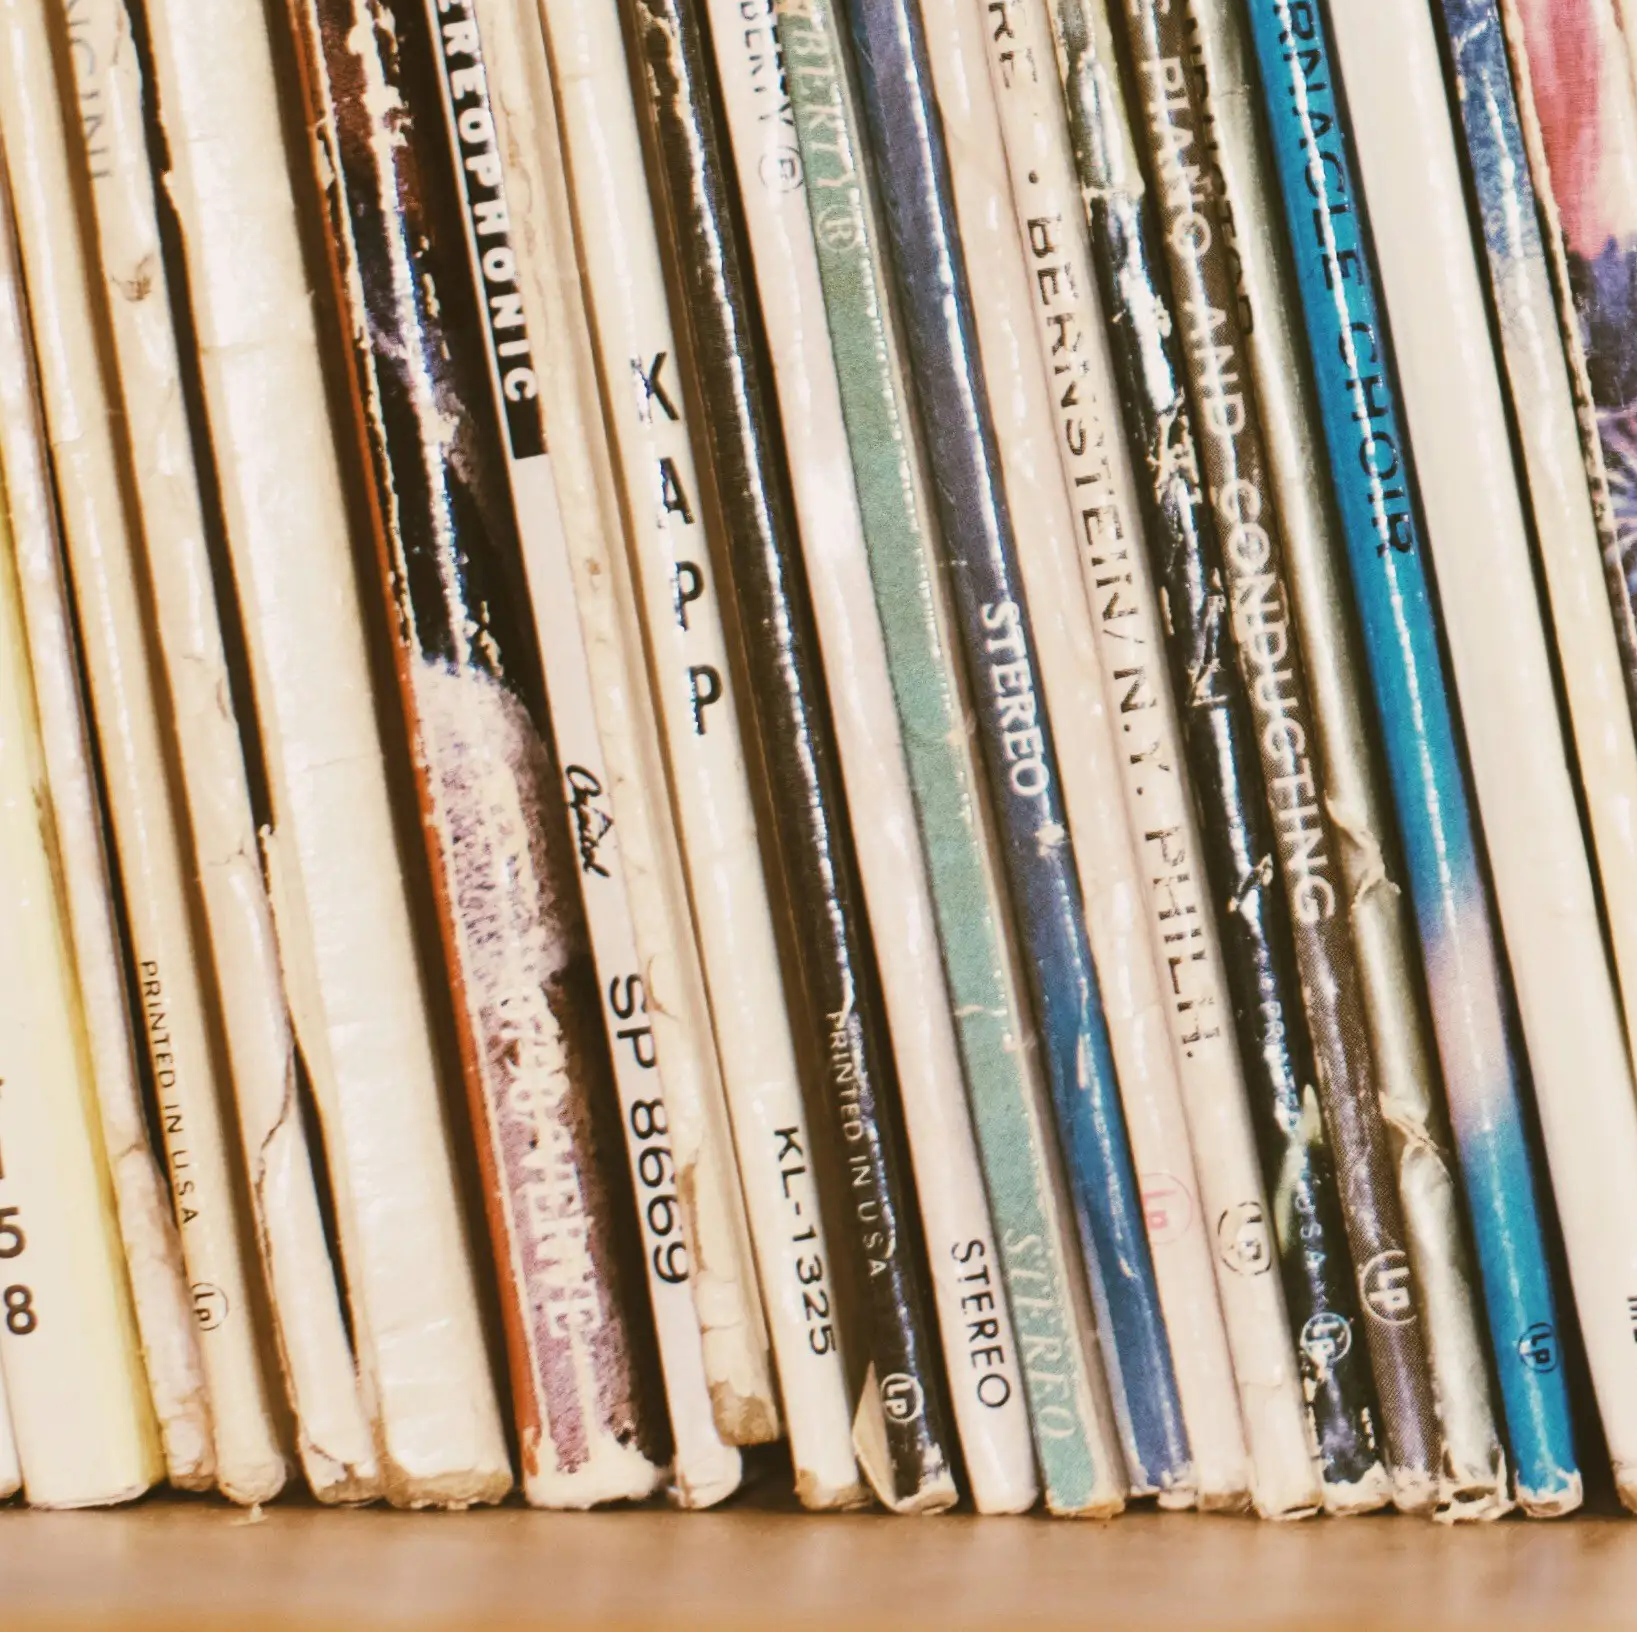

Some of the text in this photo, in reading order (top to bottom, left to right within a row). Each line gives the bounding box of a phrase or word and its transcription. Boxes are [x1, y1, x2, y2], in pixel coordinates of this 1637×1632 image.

[1137, 55, 1218, 262] PIANO
[1182, 301, 1251, 440] AND
[1330, 320, 1418, 560] CHOIR
[974, 601, 1054, 798] STEREO
[1214, 478, 1342, 925] CONDUCTING
[138, 962, 177, 1086] PRINTED
[162, 1106, 186, 1134] IN
[605, 976, 694, 1286] SP 8669
[821, 1012, 865, 1140] PRINTED
[846, 1155, 873, 1186] IN
[769, 1125, 839, 1358] KL-1325
[948, 1238, 1014, 1410] STEREO
[997, 1227, 1080, 1442] STEREO
